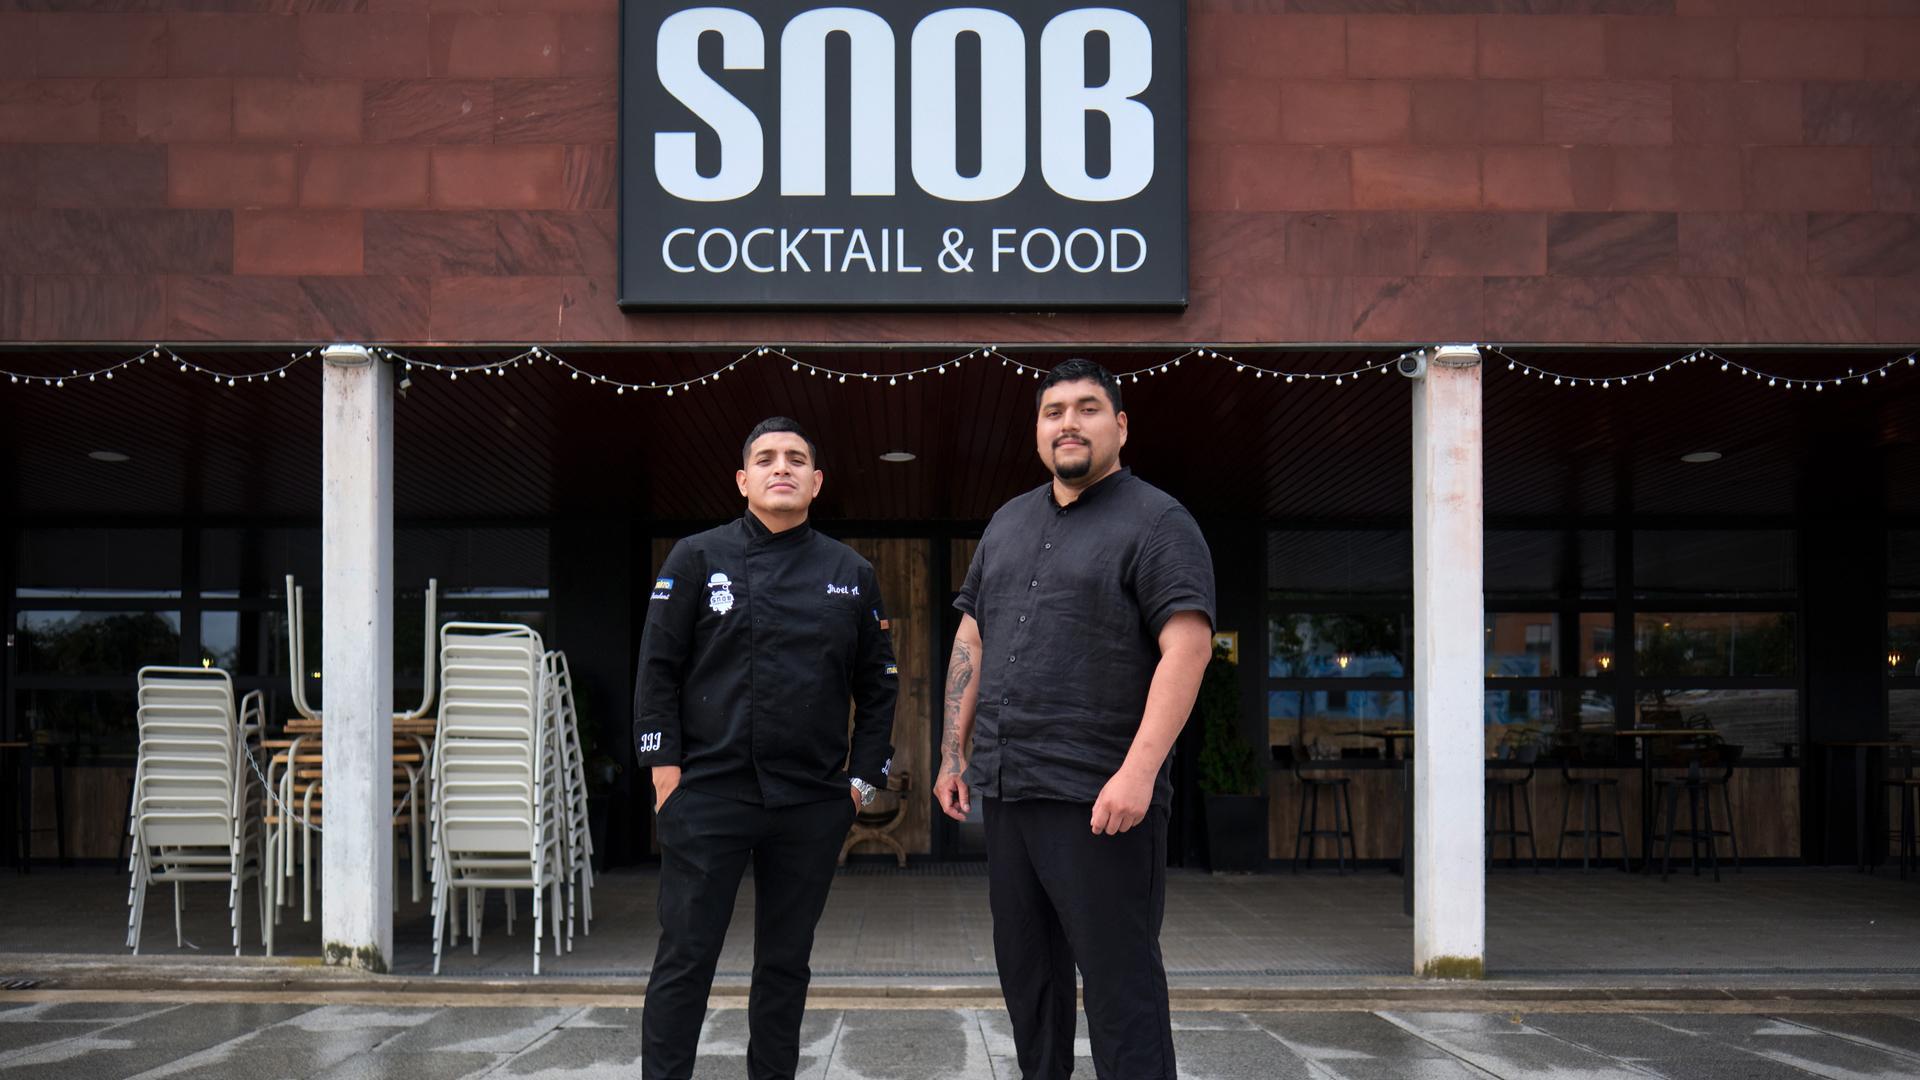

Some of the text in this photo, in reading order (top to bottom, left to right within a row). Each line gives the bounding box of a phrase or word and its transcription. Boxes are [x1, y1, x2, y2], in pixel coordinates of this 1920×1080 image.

[655, 7, 1154, 201] SNOB
[662, 228, 1147, 273] COCKTAIL & FOOD
